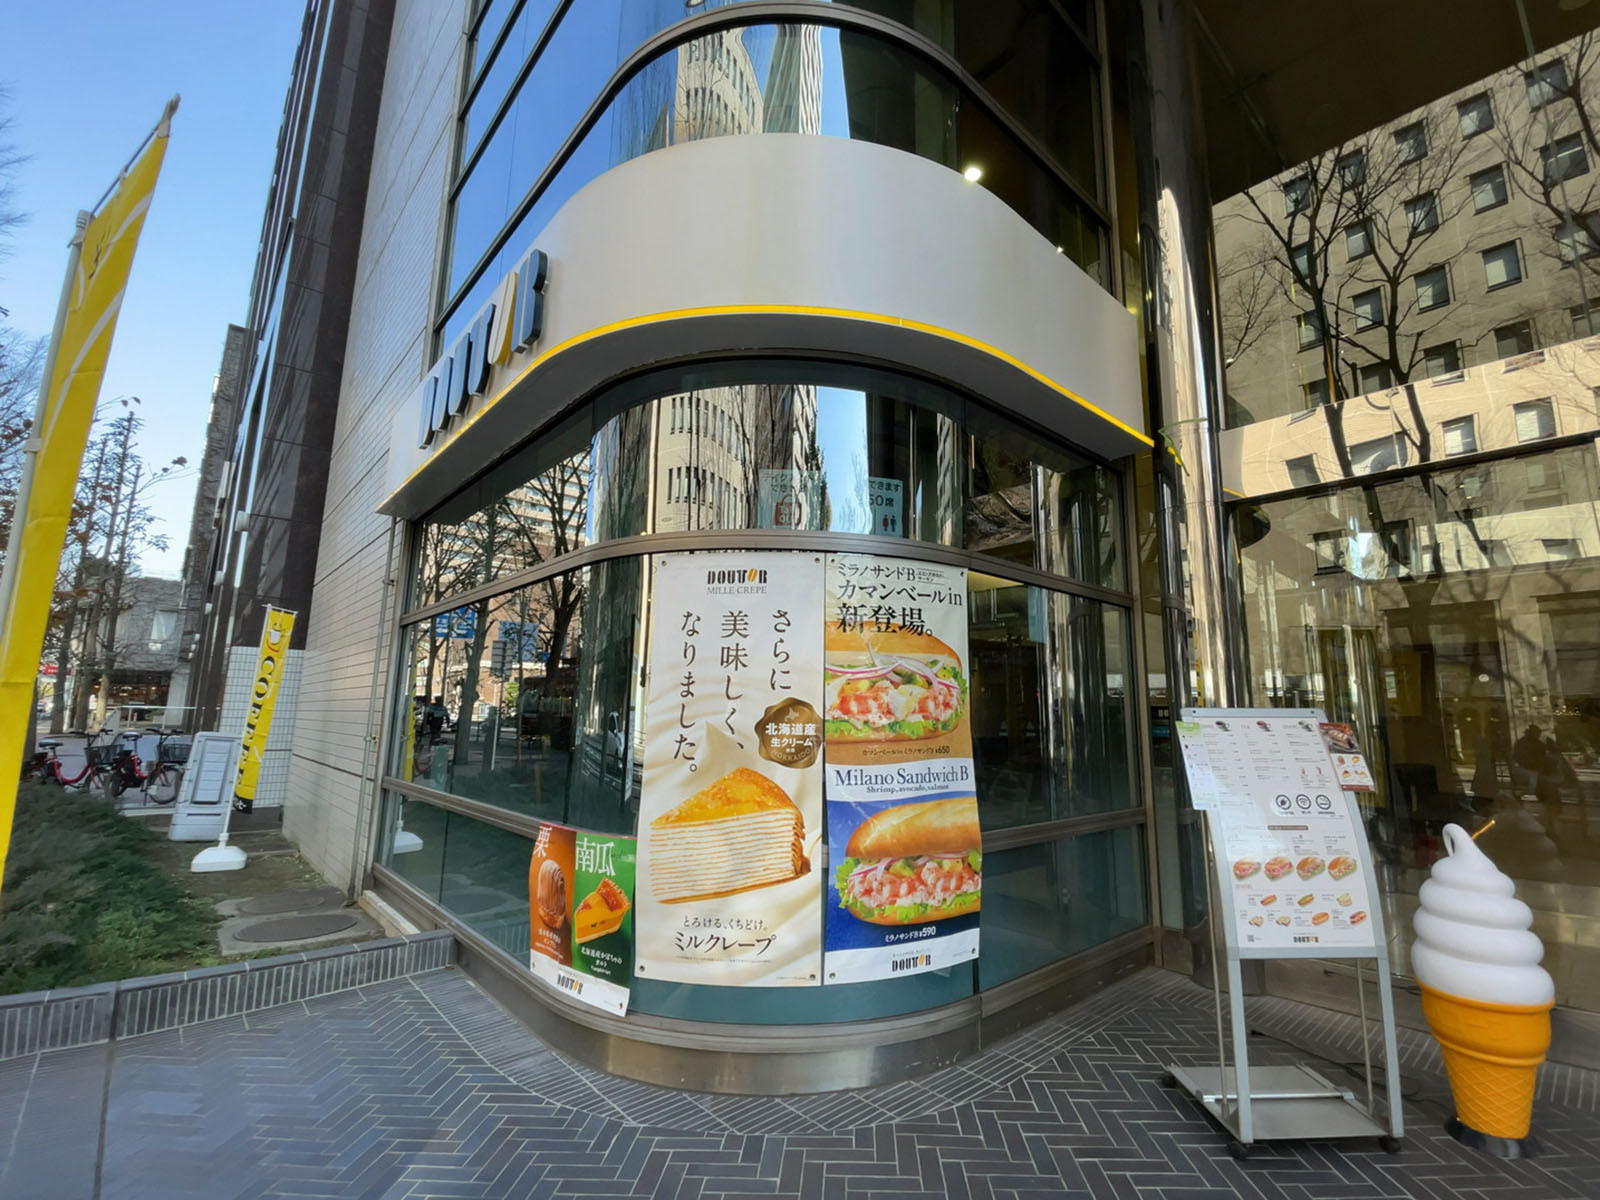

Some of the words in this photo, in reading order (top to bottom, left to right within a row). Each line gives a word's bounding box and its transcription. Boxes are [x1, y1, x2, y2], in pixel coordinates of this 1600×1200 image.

[707, 568, 768, 584] DOUTOR
[837, 563, 916, 581] ミラノサンドB
[706, 587, 735, 595] MILLE
[736, 586, 767, 594] CREPE
[837, 579, 962, 606] カマンベールin
[836, 603, 934, 637] 新登場。
[770, 609, 792, 691] さらに
[720, 610, 750, 750] 美味しく、
[673, 611, 701, 773] なりました。
[765, 722, 816, 736] 北海道産
[770, 737, 813, 747] 生クリーム
[835, 769, 894, 786] Milano
[896, 766, 958, 785] Sandwich
[960, 765, 969, 781] B
[532, 825, 552, 858] 栗
[575, 837, 616, 876] 南瓜
[683, 915, 768, 930] とろける、くちどけ。
[674, 931, 777, 955] ミルクレープ
[892, 953, 931, 972] DOUTOR
